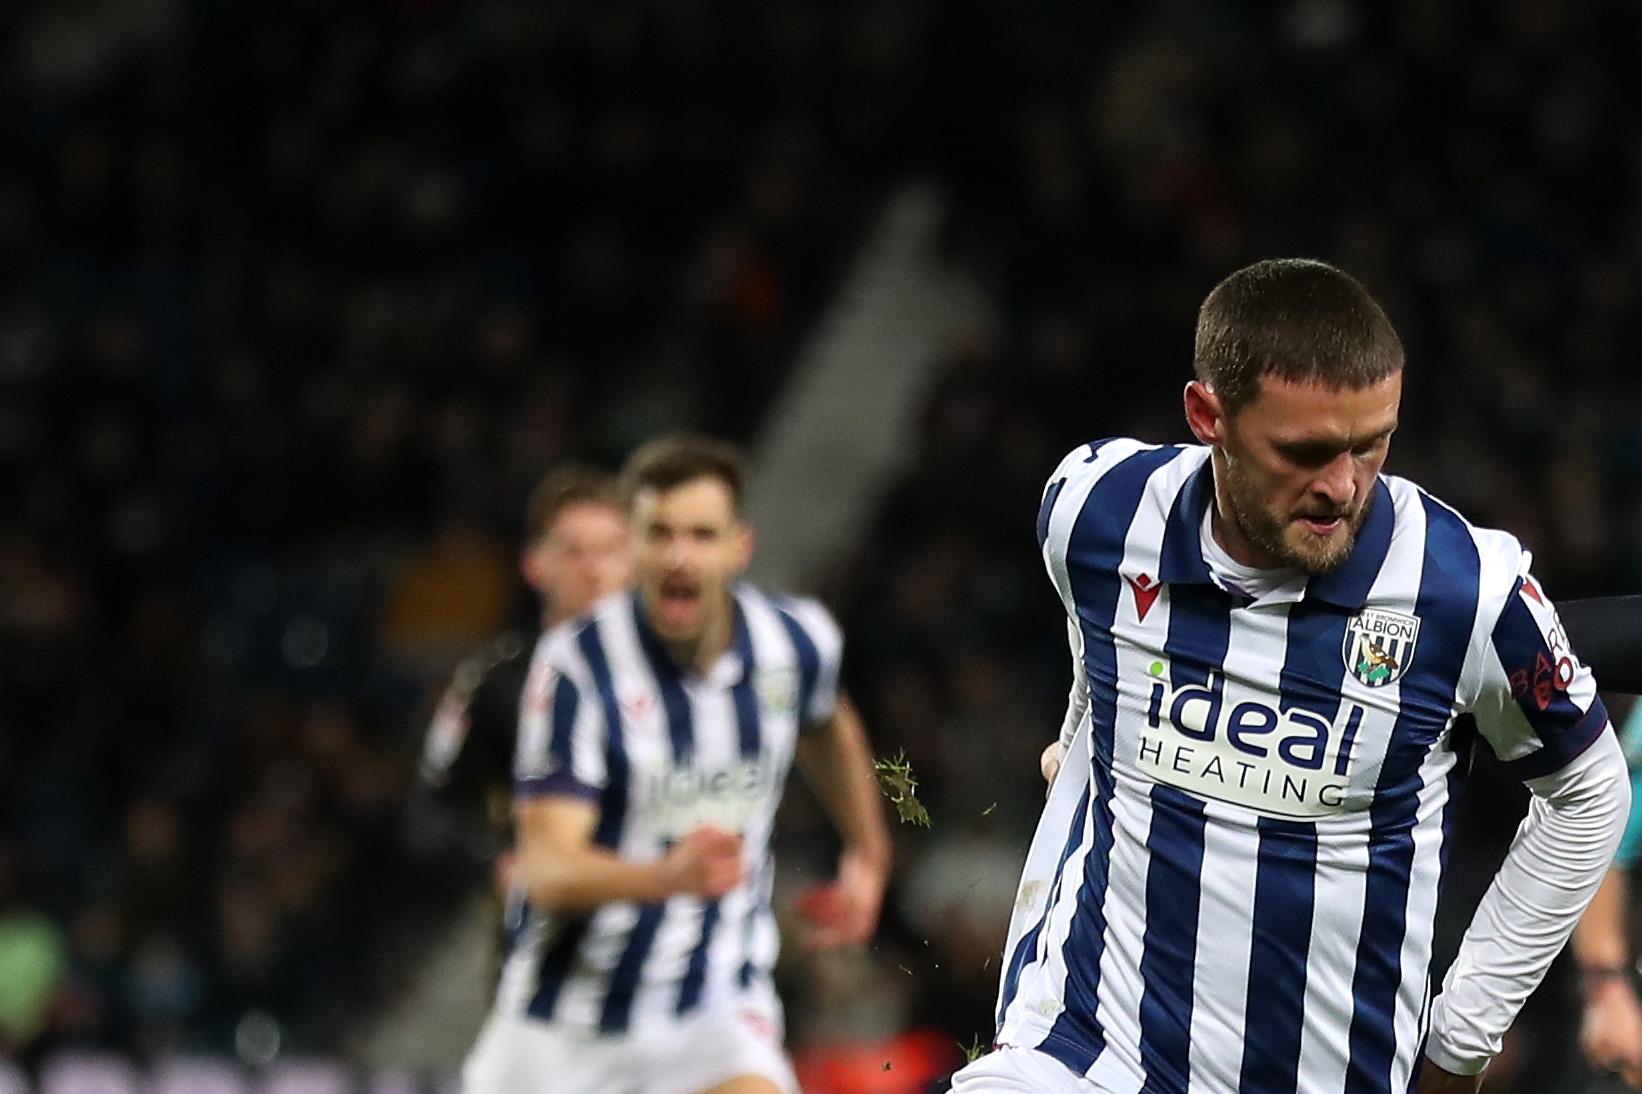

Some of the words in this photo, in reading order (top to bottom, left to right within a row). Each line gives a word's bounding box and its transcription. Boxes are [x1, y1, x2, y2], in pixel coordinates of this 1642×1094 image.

[1353, 616, 1413, 640] ALBION
[1147, 660, 1364, 777] ideal
[1138, 736, 1345, 808] HEATING
